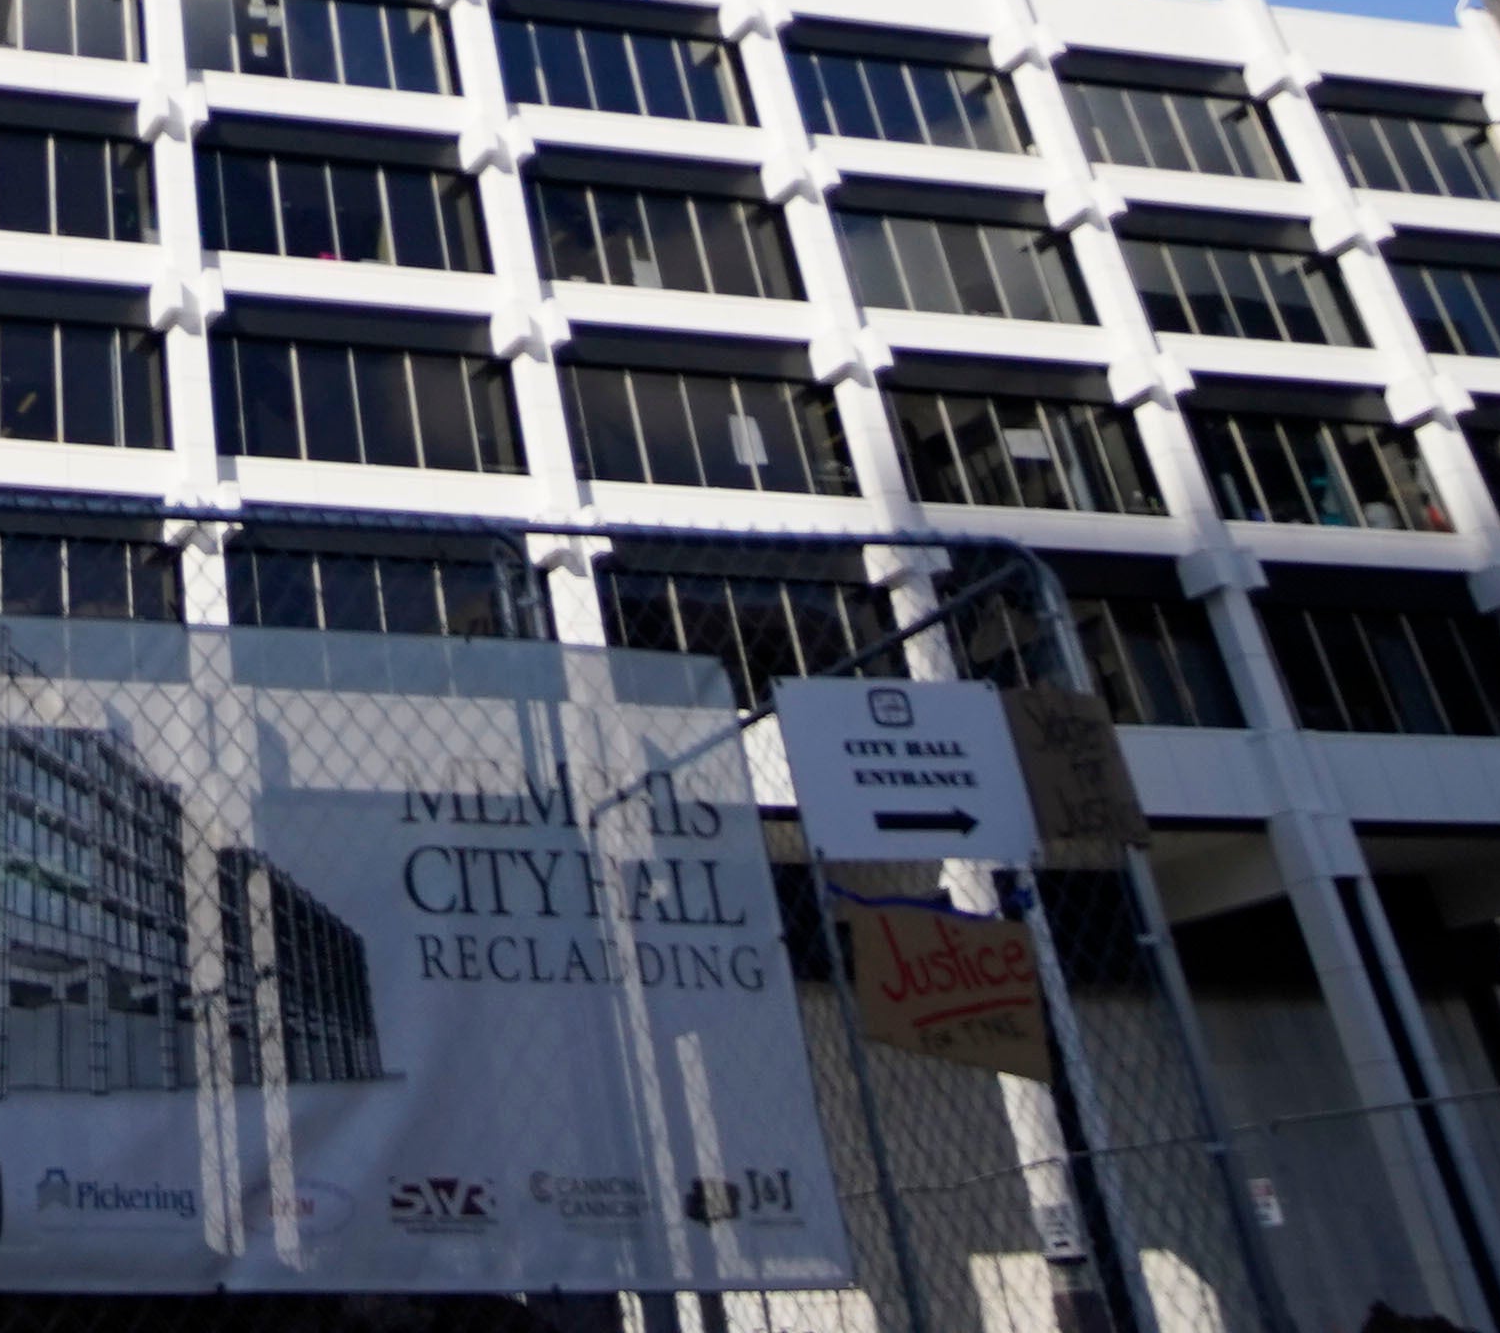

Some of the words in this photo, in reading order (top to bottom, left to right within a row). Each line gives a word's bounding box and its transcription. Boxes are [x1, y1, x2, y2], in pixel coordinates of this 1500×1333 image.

[842, 739, 896, 757] CITY
[905, 739, 967, 757] HALL
[854, 769, 978, 788] ENTRANCE
[404, 844, 564, 917] CITY
[575, 850, 746, 928] HALL
[416, 934, 765, 991] RECLADDING
[878, 913, 1036, 1002] Justice
[75, 1180, 197, 1221] Pickering
